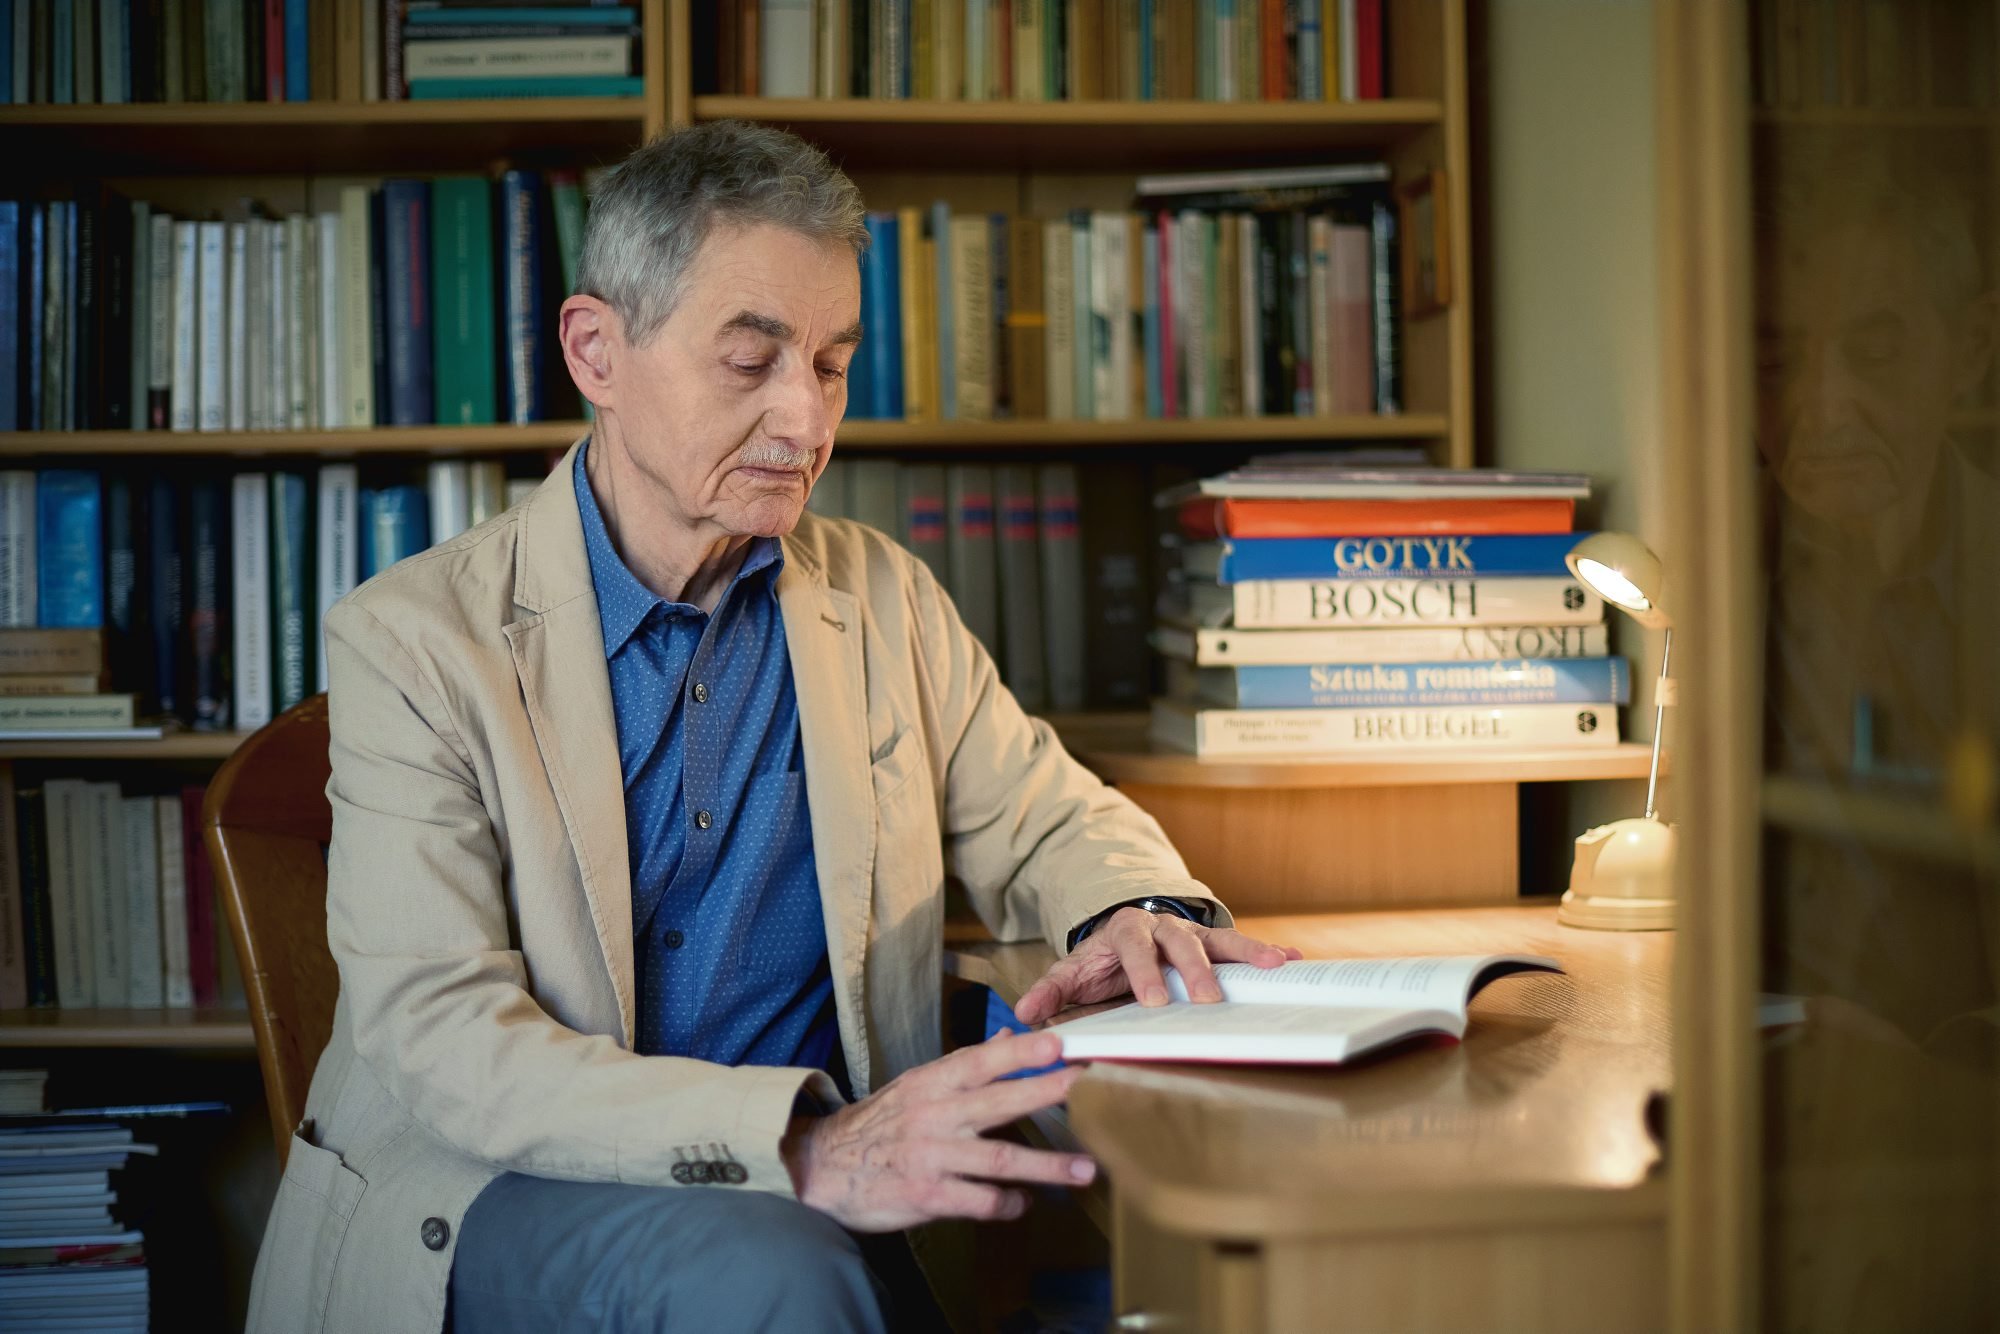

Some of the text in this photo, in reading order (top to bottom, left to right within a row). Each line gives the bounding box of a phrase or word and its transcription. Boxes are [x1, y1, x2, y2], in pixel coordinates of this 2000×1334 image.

[1333, 537, 1474, 571] GOTYK
[1310, 580, 1478, 619] BOSCH
[1455, 625, 1588, 659] IKONY
[1310, 664, 1409, 691] Sztuka
[1354, 711, 1510, 740] BRUEGEL
